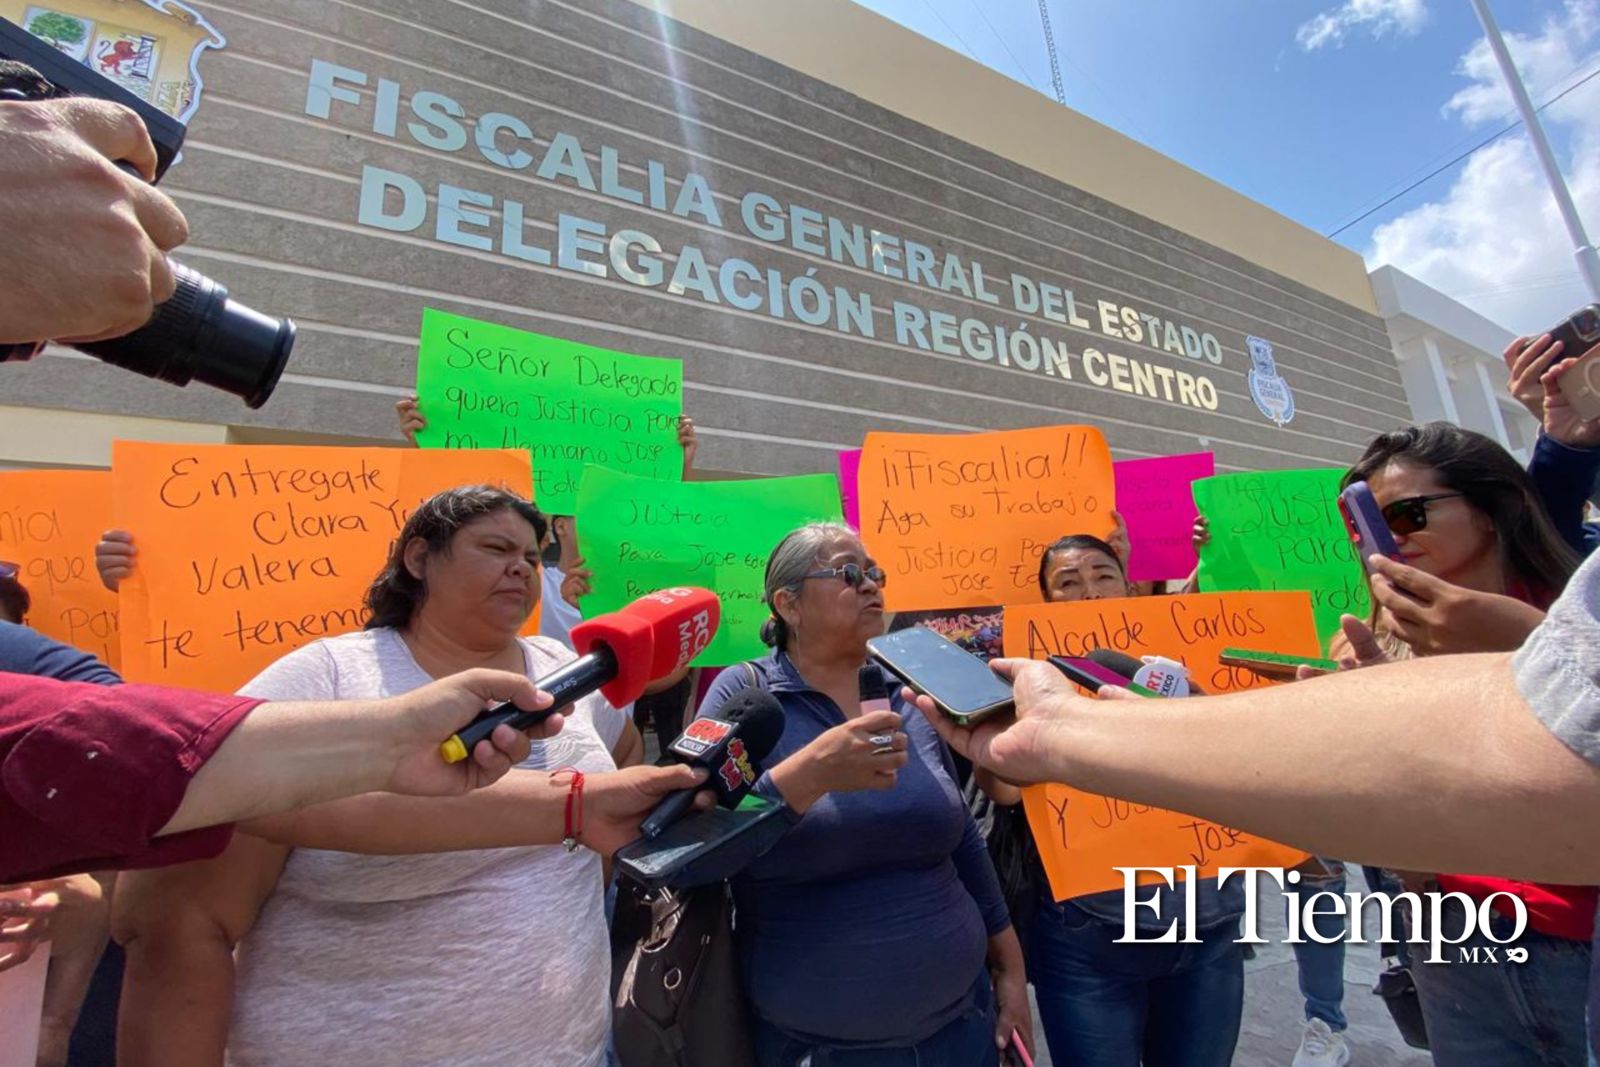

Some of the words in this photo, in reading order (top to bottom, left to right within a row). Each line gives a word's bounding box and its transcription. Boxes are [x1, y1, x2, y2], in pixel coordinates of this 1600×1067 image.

[304, 58, 722, 227] FISCALIA
[740, 192, 999, 304] GENERAL
[1010, 272, 1089, 328] DEL
[1098, 299, 1223, 365] ESTADO
[358, 165, 875, 338] DELEGACIÓN
[893, 301, 1072, 380] REGIÓN
[1082, 347, 1218, 410] CENTRO
[446, 327, 551, 378] Señor
[573, 353, 678, 398] Delegado
[528, 394, 633, 433] Justicia
[616, 440, 664, 464] Jose
[160, 456, 386, 511] Entregate
[0, 505, 62, 546] nia
[252, 502, 367, 546] Clara
[877, 500, 932, 534] Aga
[950, 503, 976, 519] su
[983, 487, 1099, 515] Trabajo
[27, 556, 90, 597] que
[192, 554, 341, 595] Valera
[618, 541, 665, 567] Para
[688, 543, 737, 572] Jose
[896, 541, 999, 575] Justicia
[1021, 537, 1046, 562] Pa
[60, 607, 119, 644] Par
[145, 620, 201, 668] te
[1026, 611, 1150, 660] Alcalde
[1170, 598, 1266, 646] Carlos
[1047, 797, 1069, 849] Y
